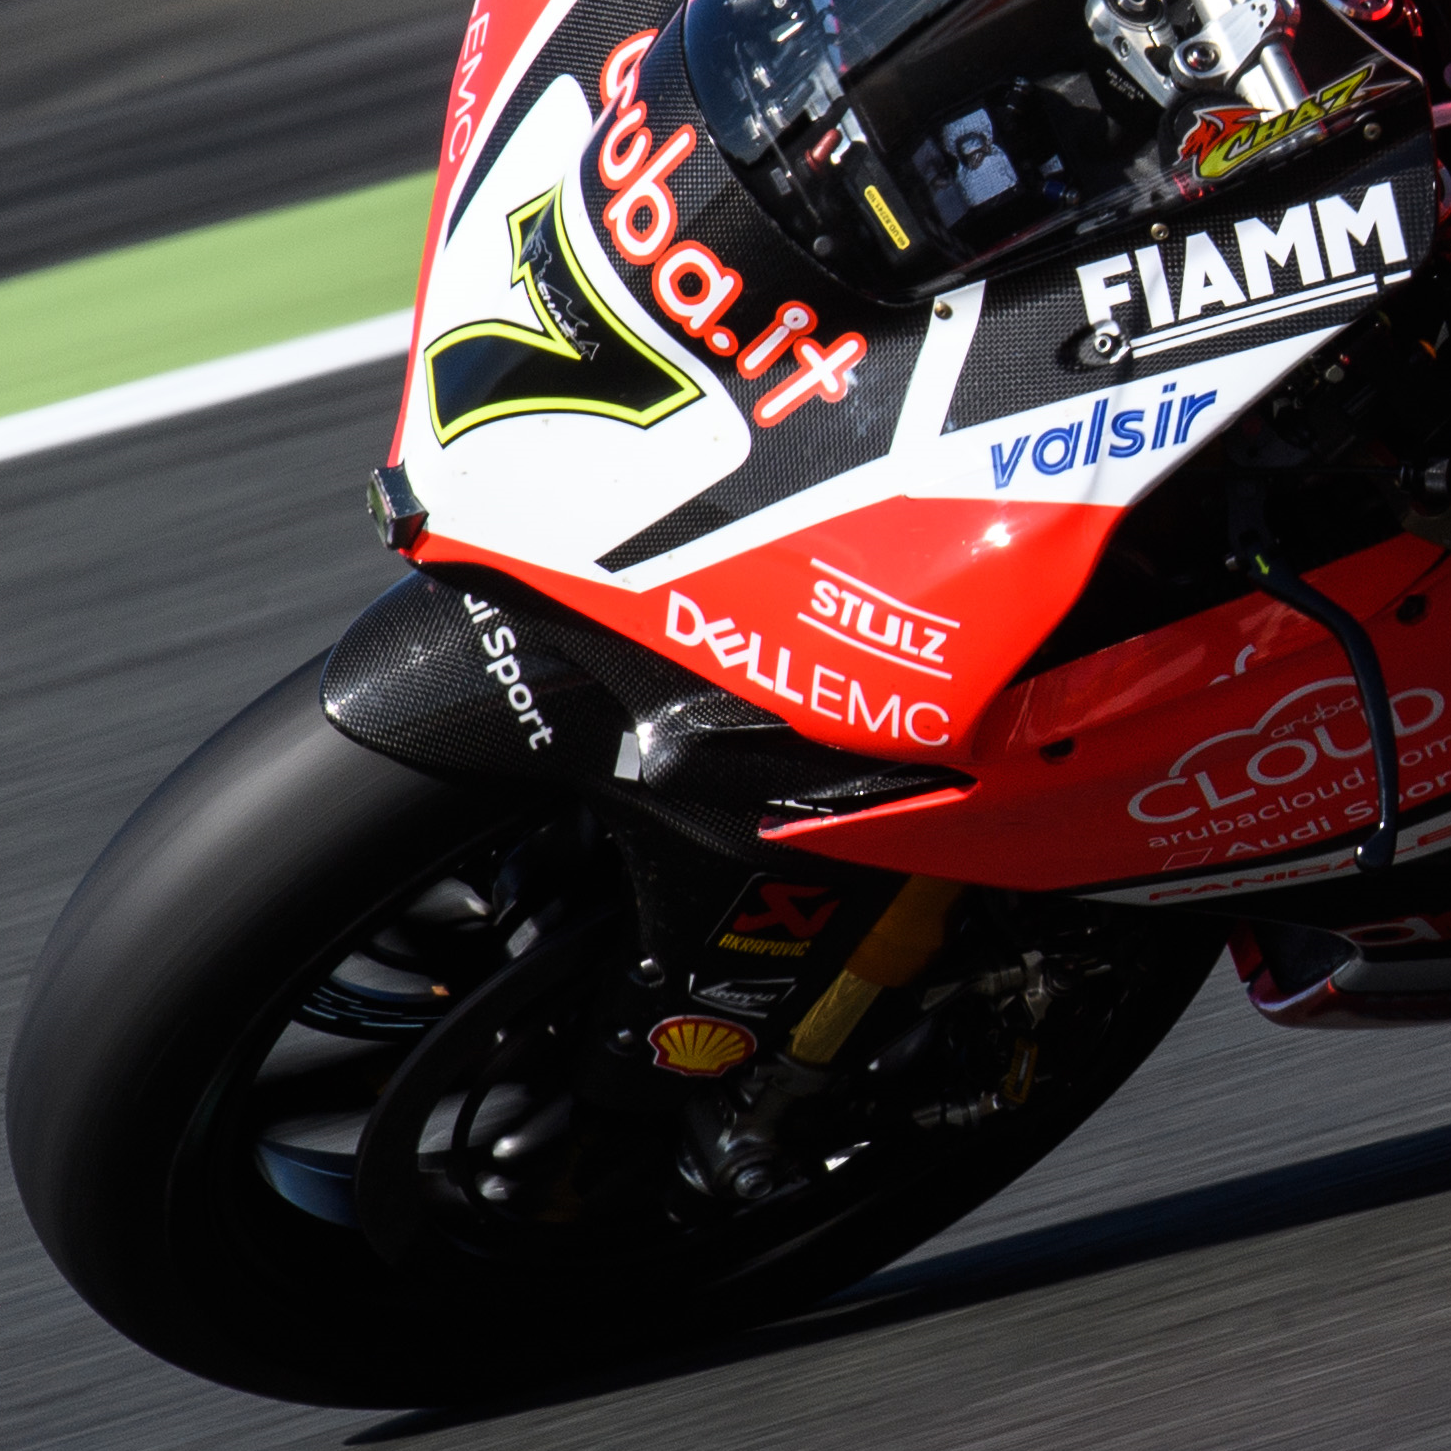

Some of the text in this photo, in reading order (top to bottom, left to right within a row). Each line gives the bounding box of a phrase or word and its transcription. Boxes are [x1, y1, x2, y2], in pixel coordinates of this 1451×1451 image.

[1076, 181, 1408, 329] FIAMM
[424, 180, 707, 450] 7
[989, 382, 1217, 490] valsir
[665, 590, 805, 706] DELL
[809, 579, 948, 664] STULZ
[481, 625, 553, 751] Sport
[1271, 696, 1359, 739] aruba
[1127, 687, 1445, 824] CLOUD
[1225, 815, 1332, 858] Audi
